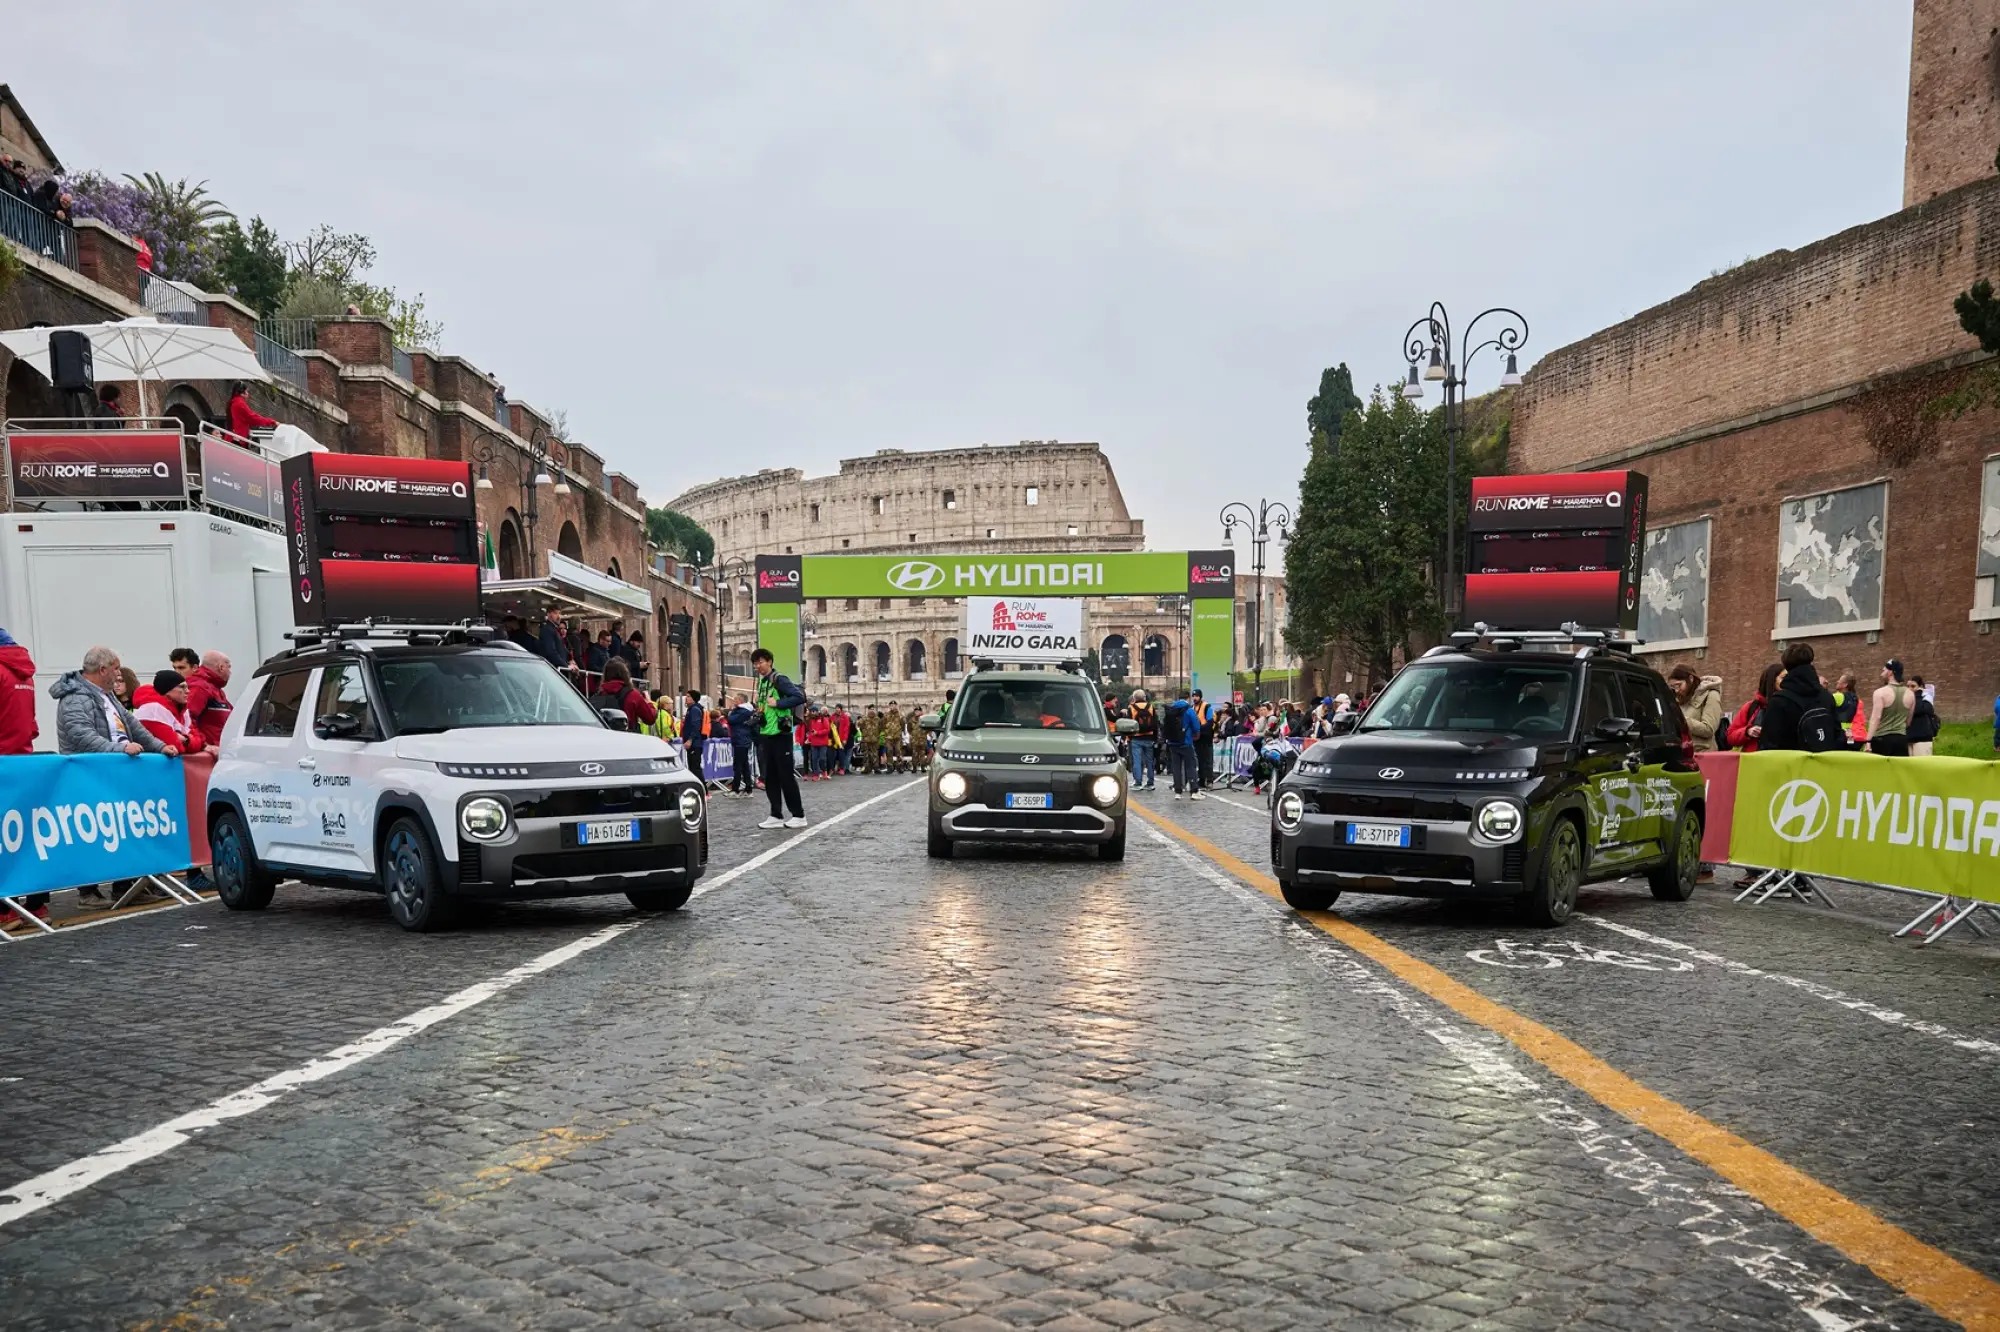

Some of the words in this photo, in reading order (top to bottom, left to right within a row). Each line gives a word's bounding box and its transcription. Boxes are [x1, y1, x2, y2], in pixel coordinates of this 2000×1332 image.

[111, 467, 151, 475] MARATHON
[411, 485, 449, 493] MARATHON
[1563, 497, 1603, 505] MARATHON
[291, 479, 306, 576] EVODATA
[1627, 493, 1640, 583] EVODATA
[954, 563, 1103, 587] HYUNDAI
[1011, 601, 1036, 611] RUN
[1016, 612, 1047, 621] ROME
[972, 635, 1024, 649] INIZIO
[1027, 636, 1078, 650] GARA
[323, 775, 352, 787] HYUNDAI
[32, 798, 177, 861] progress.
[1836, 789, 2000, 857] HYUNDA
